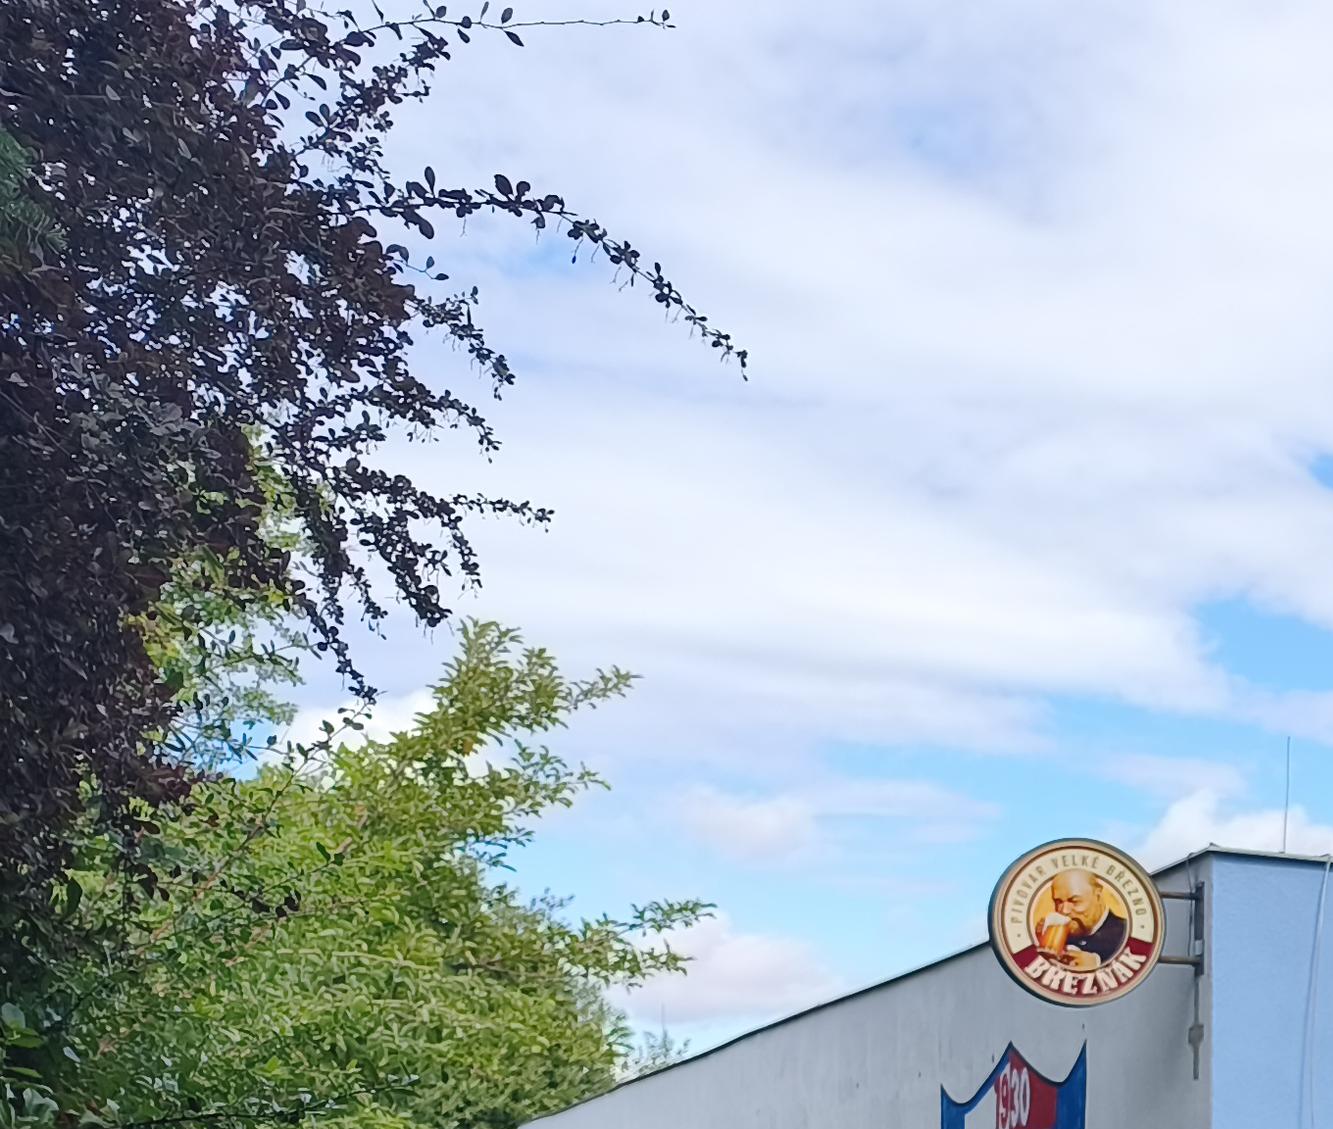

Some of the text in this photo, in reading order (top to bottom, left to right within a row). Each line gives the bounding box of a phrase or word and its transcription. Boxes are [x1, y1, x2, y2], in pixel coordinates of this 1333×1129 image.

[1010, 854, 1148, 924] PIVOVAR VELKÉ BŘEZNO
